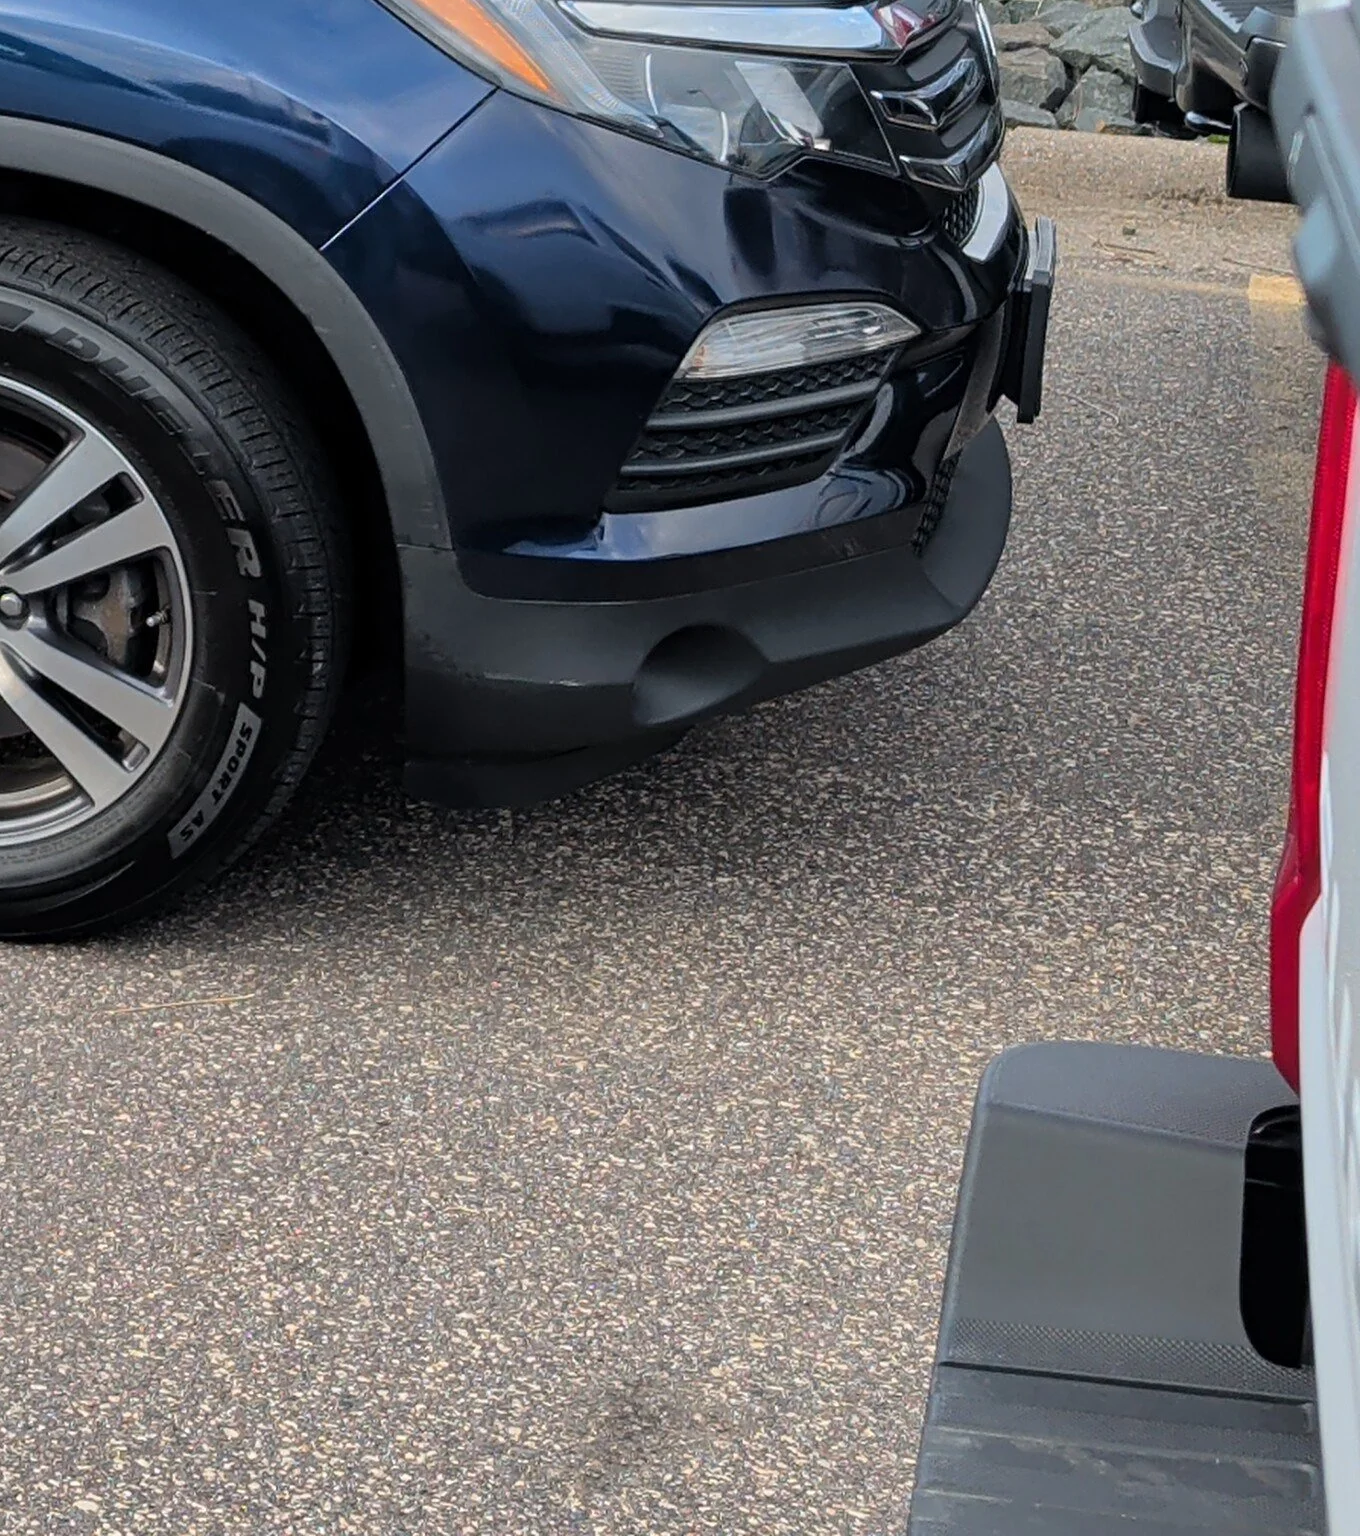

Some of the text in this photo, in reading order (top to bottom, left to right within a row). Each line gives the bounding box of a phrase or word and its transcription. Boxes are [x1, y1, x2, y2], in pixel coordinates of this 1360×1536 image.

[44, 326, 269, 845] DUELER H/P SPORT AS
